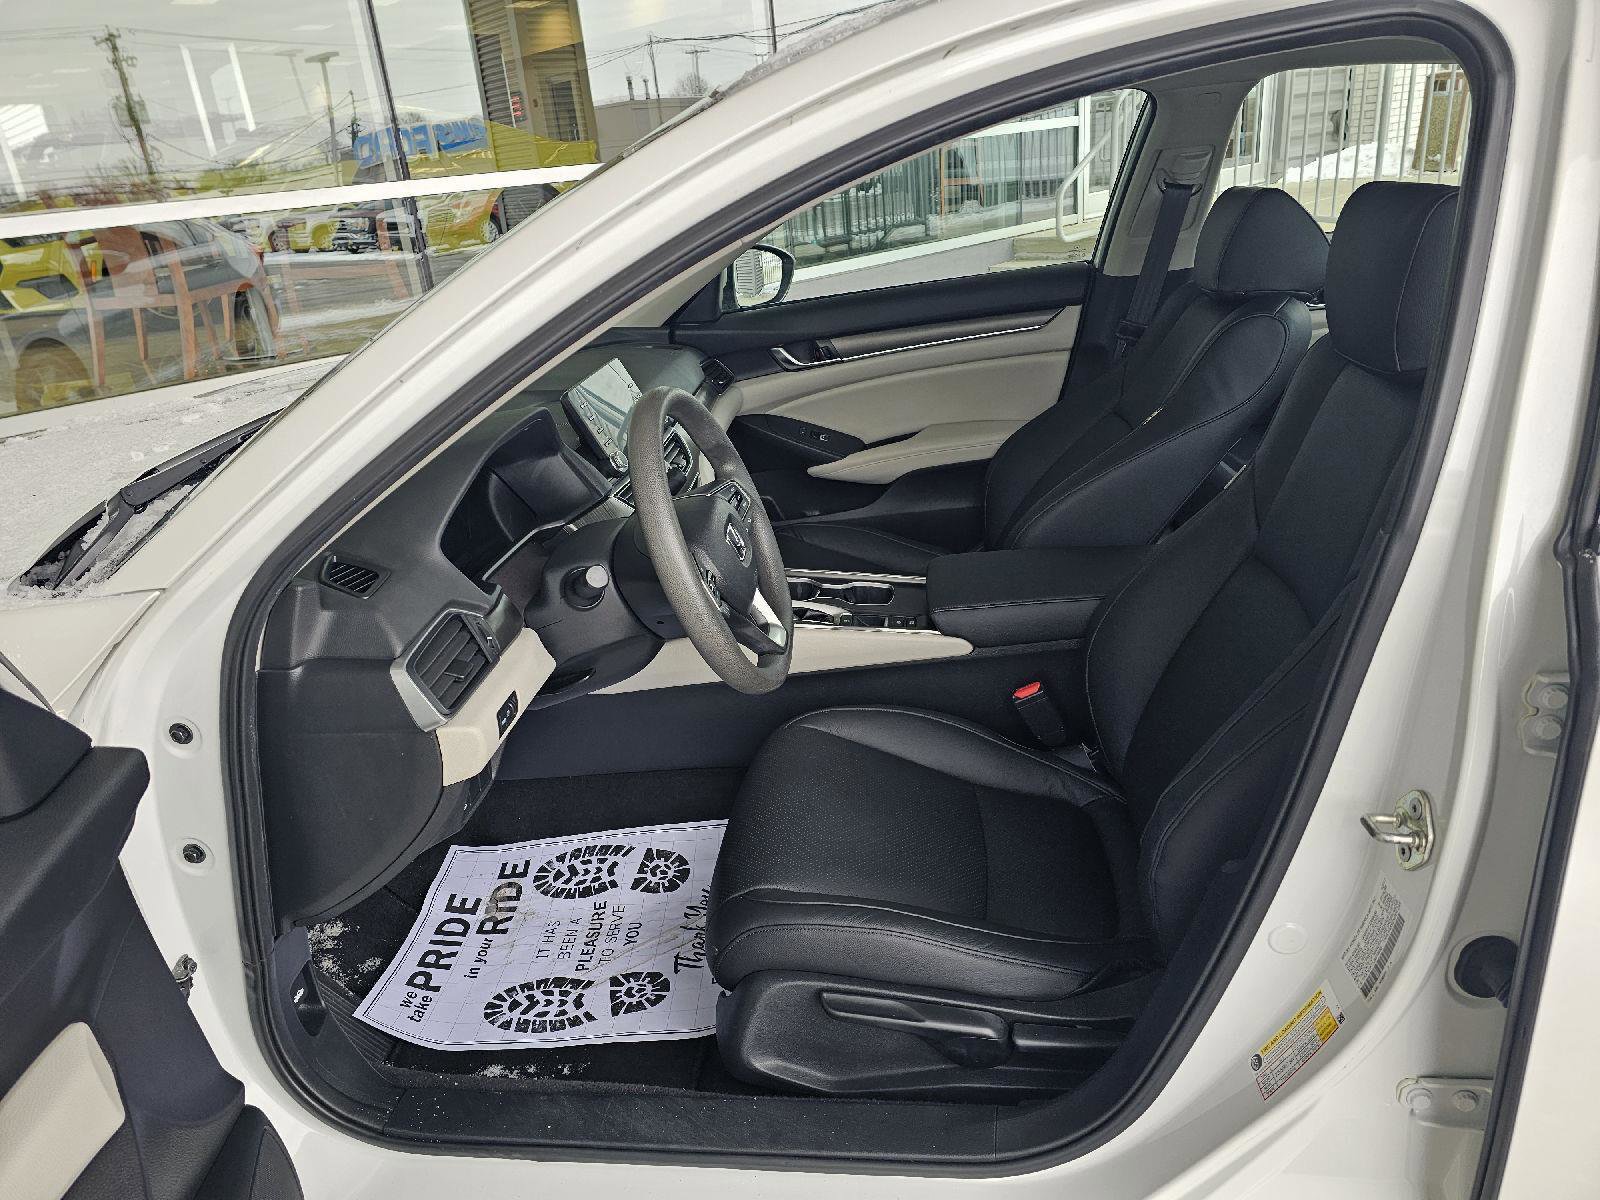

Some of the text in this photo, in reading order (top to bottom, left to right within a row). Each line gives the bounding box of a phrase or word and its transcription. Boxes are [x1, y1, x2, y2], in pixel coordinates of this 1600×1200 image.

[476, 860, 531, 934] RIDE
[405, 894, 482, 992] PRIDE
[536, 920, 561, 958] IT HAS
[557, 917, 582, 960] BEEN A
[575, 900, 607, 971] PLEASURE
[598, 904, 626, 965] TO SERVE
[623, 922, 643, 947] YOU
[674, 924, 706, 974] Thank
[464, 938, 493, 978] in your
[400, 991, 417, 1008] we
[407, 995, 433, 1022] take
